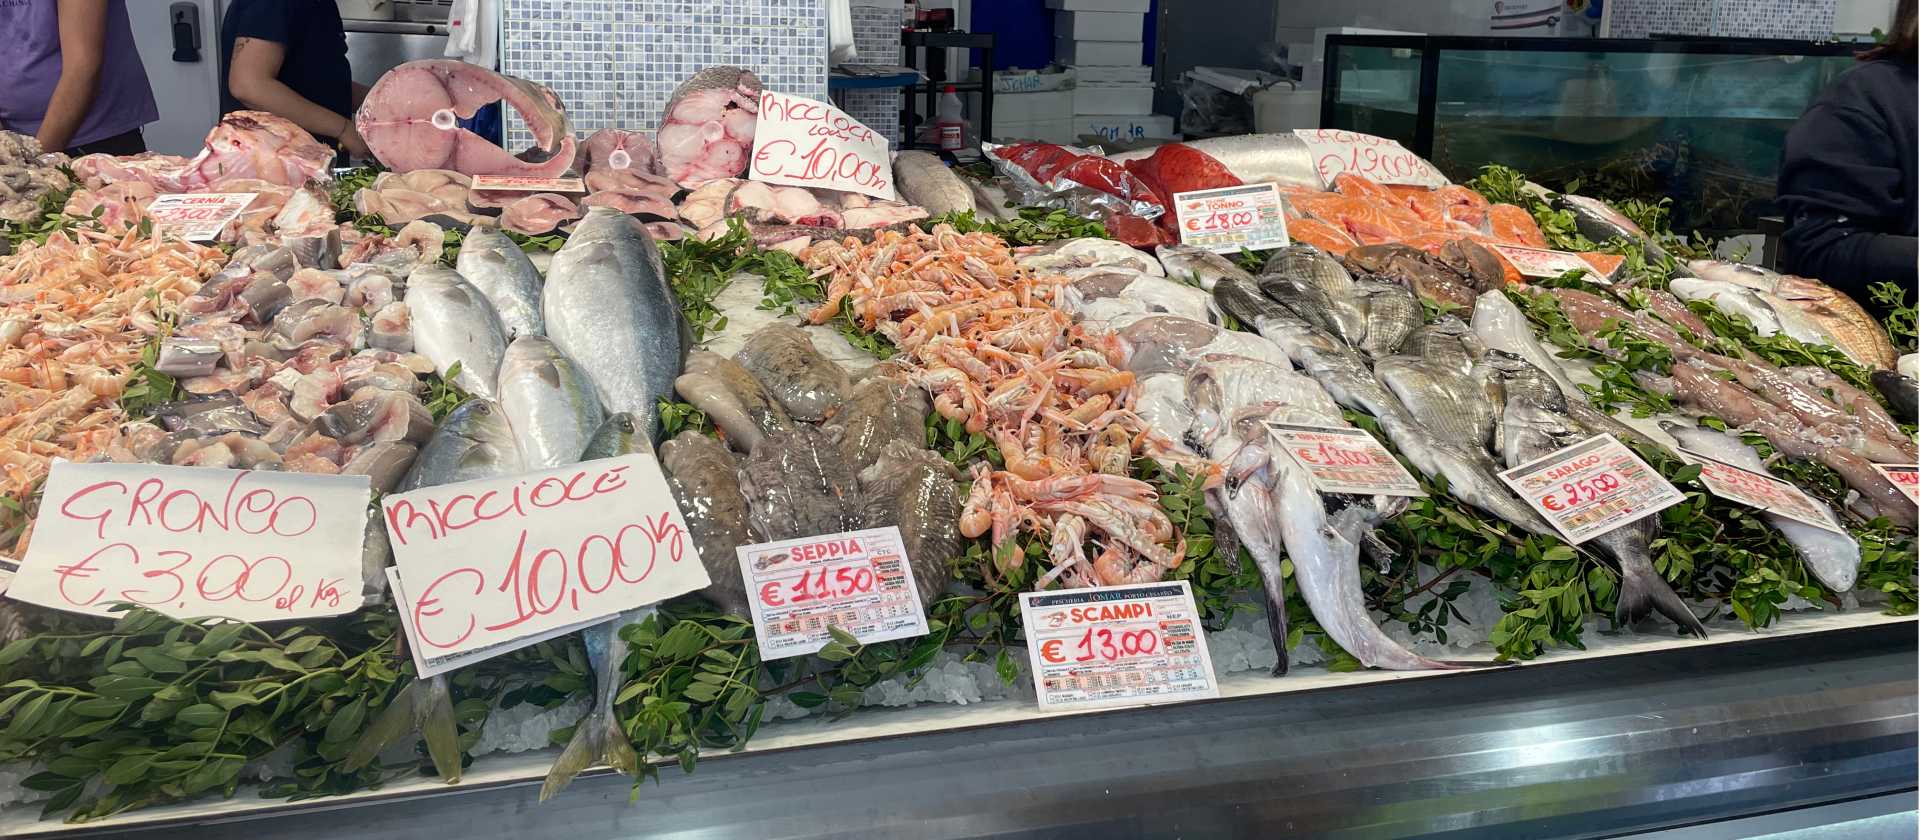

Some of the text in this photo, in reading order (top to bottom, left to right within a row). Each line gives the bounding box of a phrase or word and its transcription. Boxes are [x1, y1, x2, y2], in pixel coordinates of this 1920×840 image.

[754, 140, 796, 175] €
[1207, 200, 1244, 210] TONNO
[1186, 218, 1201, 230] €
[1297, 448, 1319, 464] €
[1547, 455, 1600, 480] SARAGO
[1542, 495, 1566, 511] €
[791, 537, 863, 562] SEPPIA
[54, 543, 140, 606] €
[760, 581, 785, 606] €
[791, 566, 874, 602] 11,50
[415, 568, 484, 648] €
[1070, 603, 1153, 623] SCAMPI
[1040, 639, 1067, 663] €
